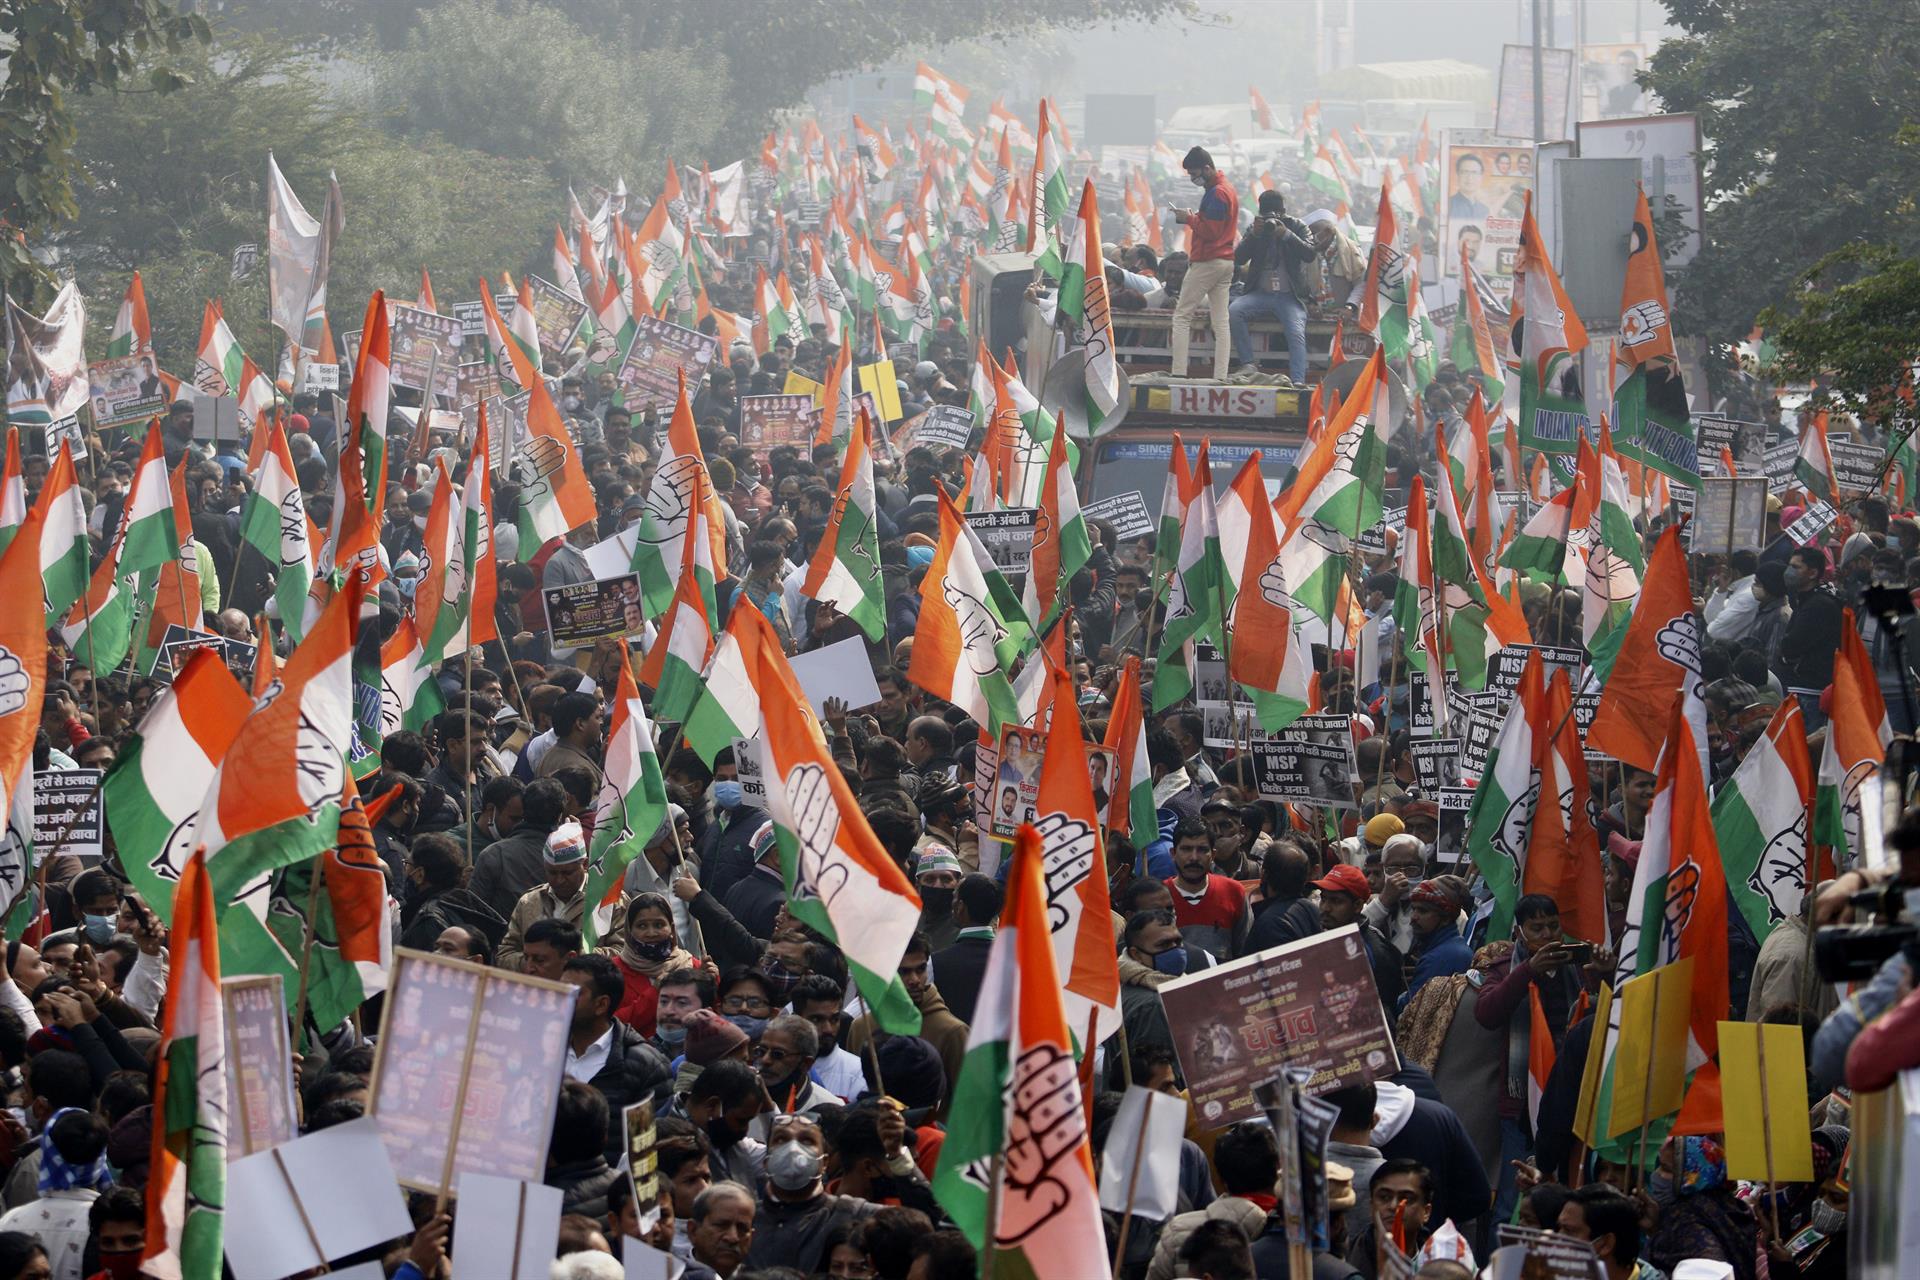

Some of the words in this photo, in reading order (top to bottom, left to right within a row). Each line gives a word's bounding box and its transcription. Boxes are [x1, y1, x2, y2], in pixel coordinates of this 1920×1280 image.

[1533, 408, 1570, 442] INDIAN
[1138, 444, 1188, 454] SINCEE
[987, 528, 1011, 546] कृषि
[1363, 535, 1371, 543] पर
[1541, 649, 1556, 660] यही
[1556, 653, 1580, 662] आवाज
[1413, 676, 1423, 684] हर
[1496, 673, 1504, 684] से
[1420, 702, 1429, 713] से
[1573, 707, 1594, 723] SP
[1325, 719, 1347, 729] आवाज
[1284, 731, 1309, 742] MSP
[1471, 725, 1490, 744] MSP
[1254, 745, 1264, 754] हर
[1264, 743, 1292, 754] किसान
[1294, 743, 1305, 754] की
[1306, 745, 1319, 756] यही
[1320, 750, 1345, 760] आवाज
[1473, 747, 1483, 757] कम
[1265, 755, 1298, 770] MSP
[54, 774, 63, 787] से
[64, 775, 98, 786] छलावा
[1265, 771, 1274, 782] से
[1276, 773, 1293, 782] कम
[1295, 773, 1303, 782] न
[1261, 781, 1282, 793] बिके
[1284, 785, 1310, 795] अनाज
[50, 792, 66, 805] को
[1443, 794, 1462, 809] मोदी
[85, 809, 97, 823] में
[1238, 1004, 1317, 1051] घेराव
